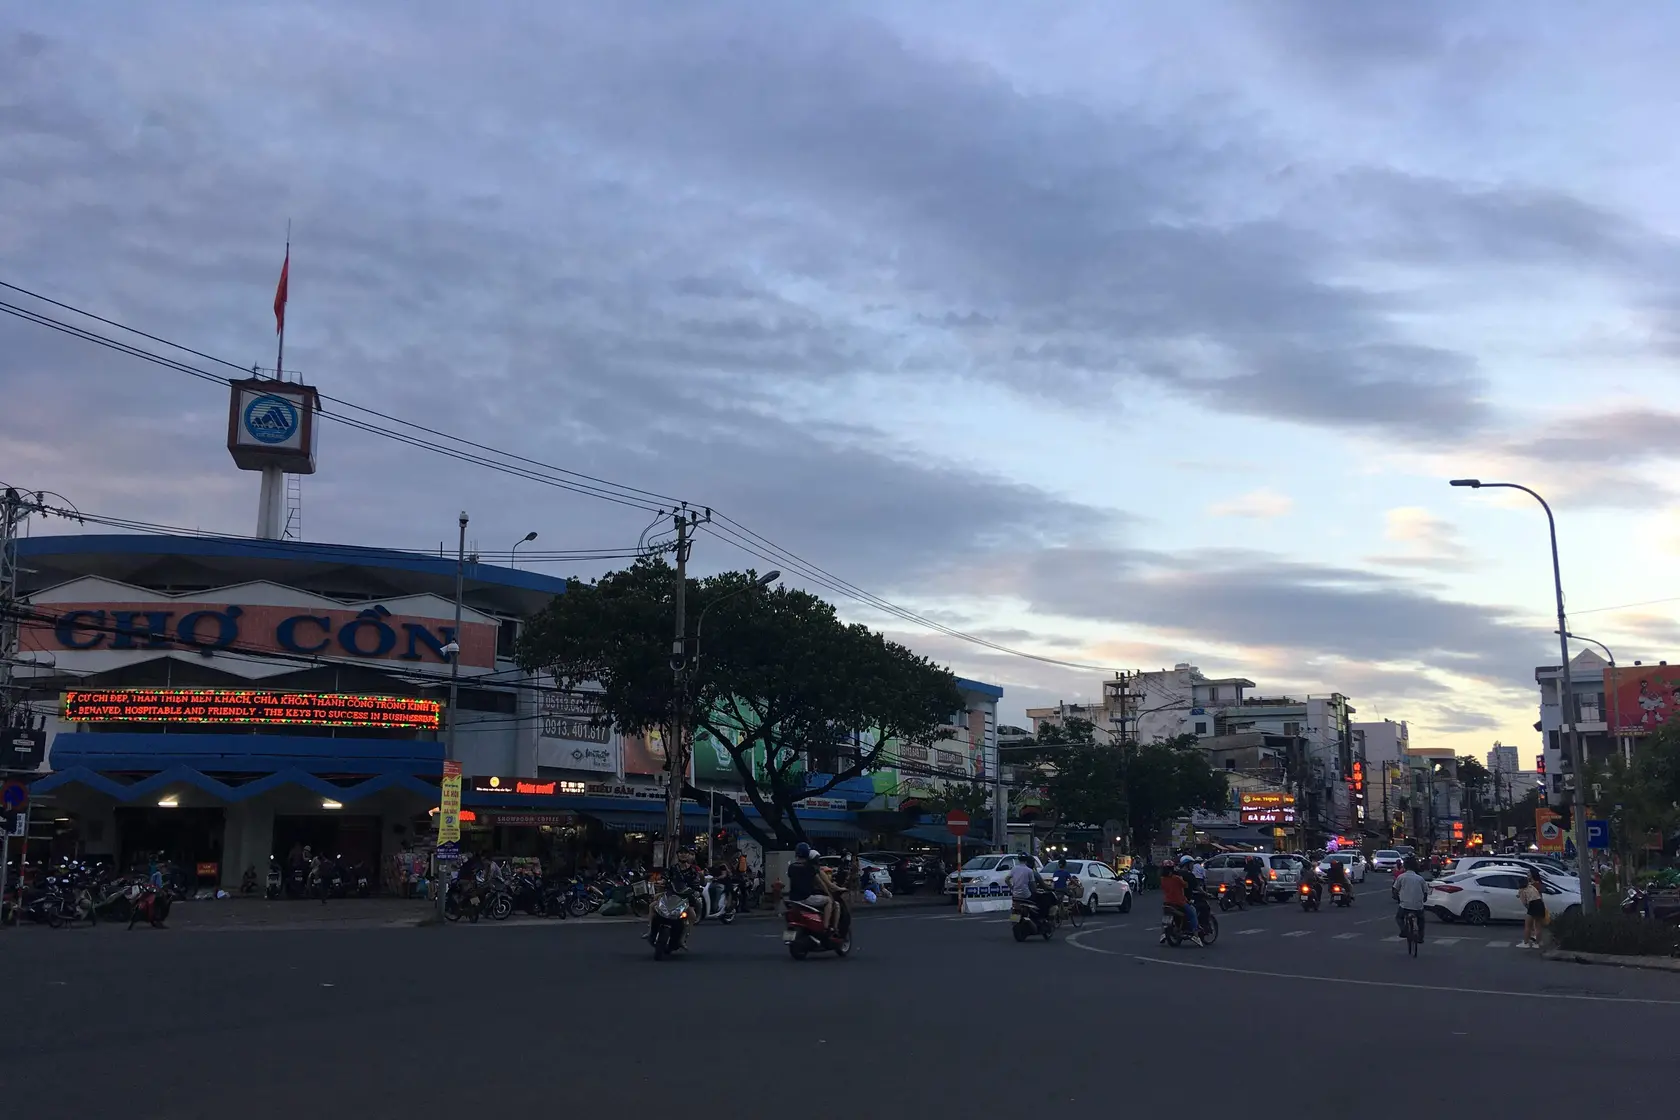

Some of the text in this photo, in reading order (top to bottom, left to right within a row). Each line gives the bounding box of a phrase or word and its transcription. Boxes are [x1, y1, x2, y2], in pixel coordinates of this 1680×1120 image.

[54, 603, 458, 661] CHỢ CỒN
[124, 706, 182, 714] HOSPITABLE
[207, 706, 256, 715] FRIENDLY
[263, 708, 283, 716] THE
[285, 709, 311, 717] KEYS
[313, 709, 326, 717] TO
[327, 711, 367, 720] SUCCESS
[1587, 826, 1602, 842] P
